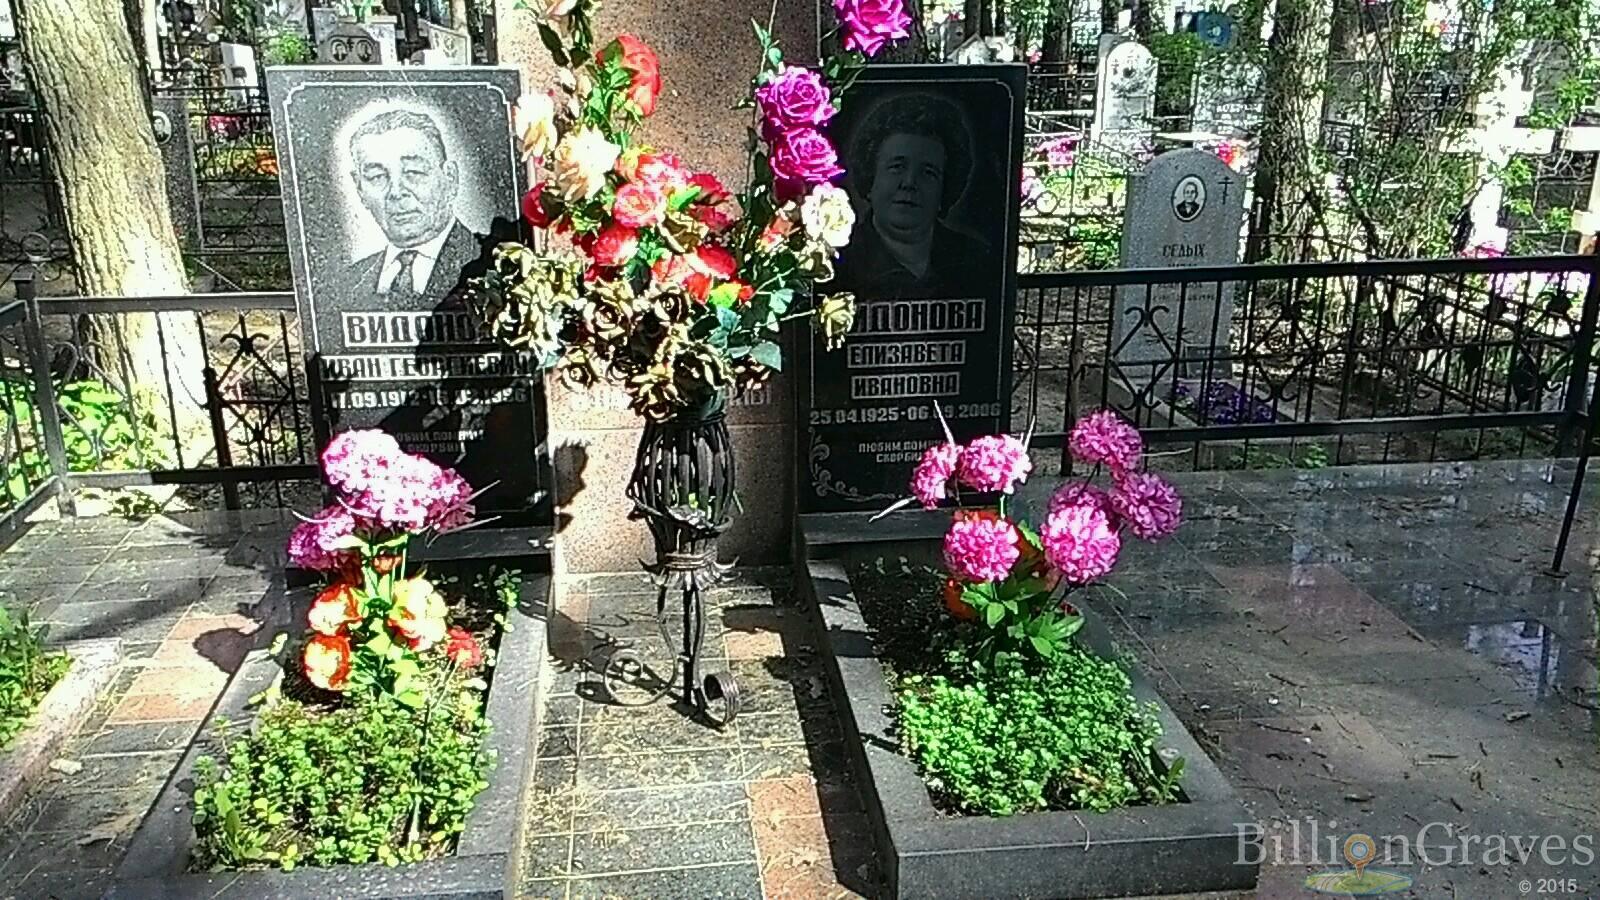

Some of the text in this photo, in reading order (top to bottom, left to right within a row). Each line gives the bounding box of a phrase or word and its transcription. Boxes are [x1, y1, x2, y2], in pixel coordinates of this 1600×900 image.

[343, 312, 495, 347] ВИДОНО
[848, 298, 986, 335] ИДОНОВА
[321, 355, 382, 380] ИВАН
[849, 341, 966, 367] ЕЛИЗАВЕТА
[852, 371, 960, 399] ИВАНОВНА
